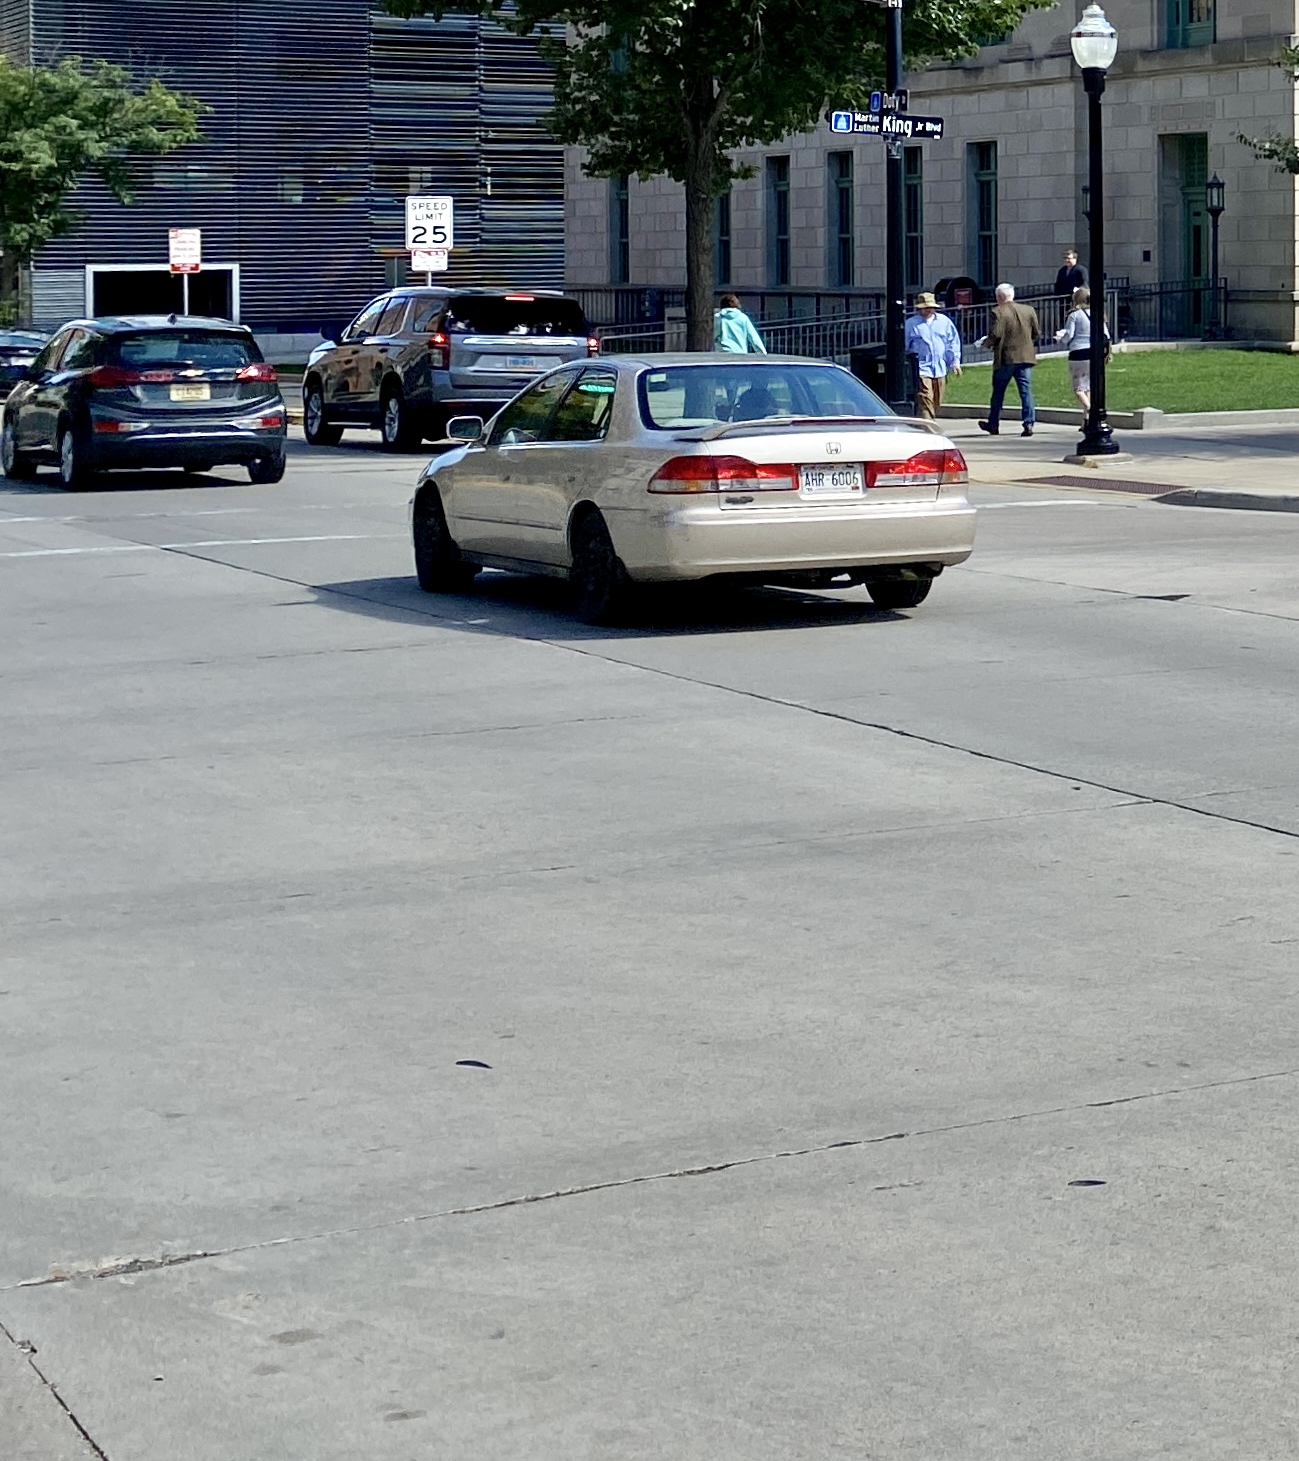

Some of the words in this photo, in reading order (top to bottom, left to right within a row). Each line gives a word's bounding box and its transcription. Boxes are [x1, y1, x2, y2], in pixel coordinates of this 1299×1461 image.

[854, 112, 880, 123] Martin
[853, 122, 880, 133] Luther
[882, 115, 913, 138] King
[915, 121, 924, 131] Jr
[925, 122, 942, 132] Blvd
[411, 202, 448, 210] SPEED
[415, 212, 444, 221] LIMIT
[411, 225, 447, 244] 25
[804, 471, 859, 487] AHR-6006
